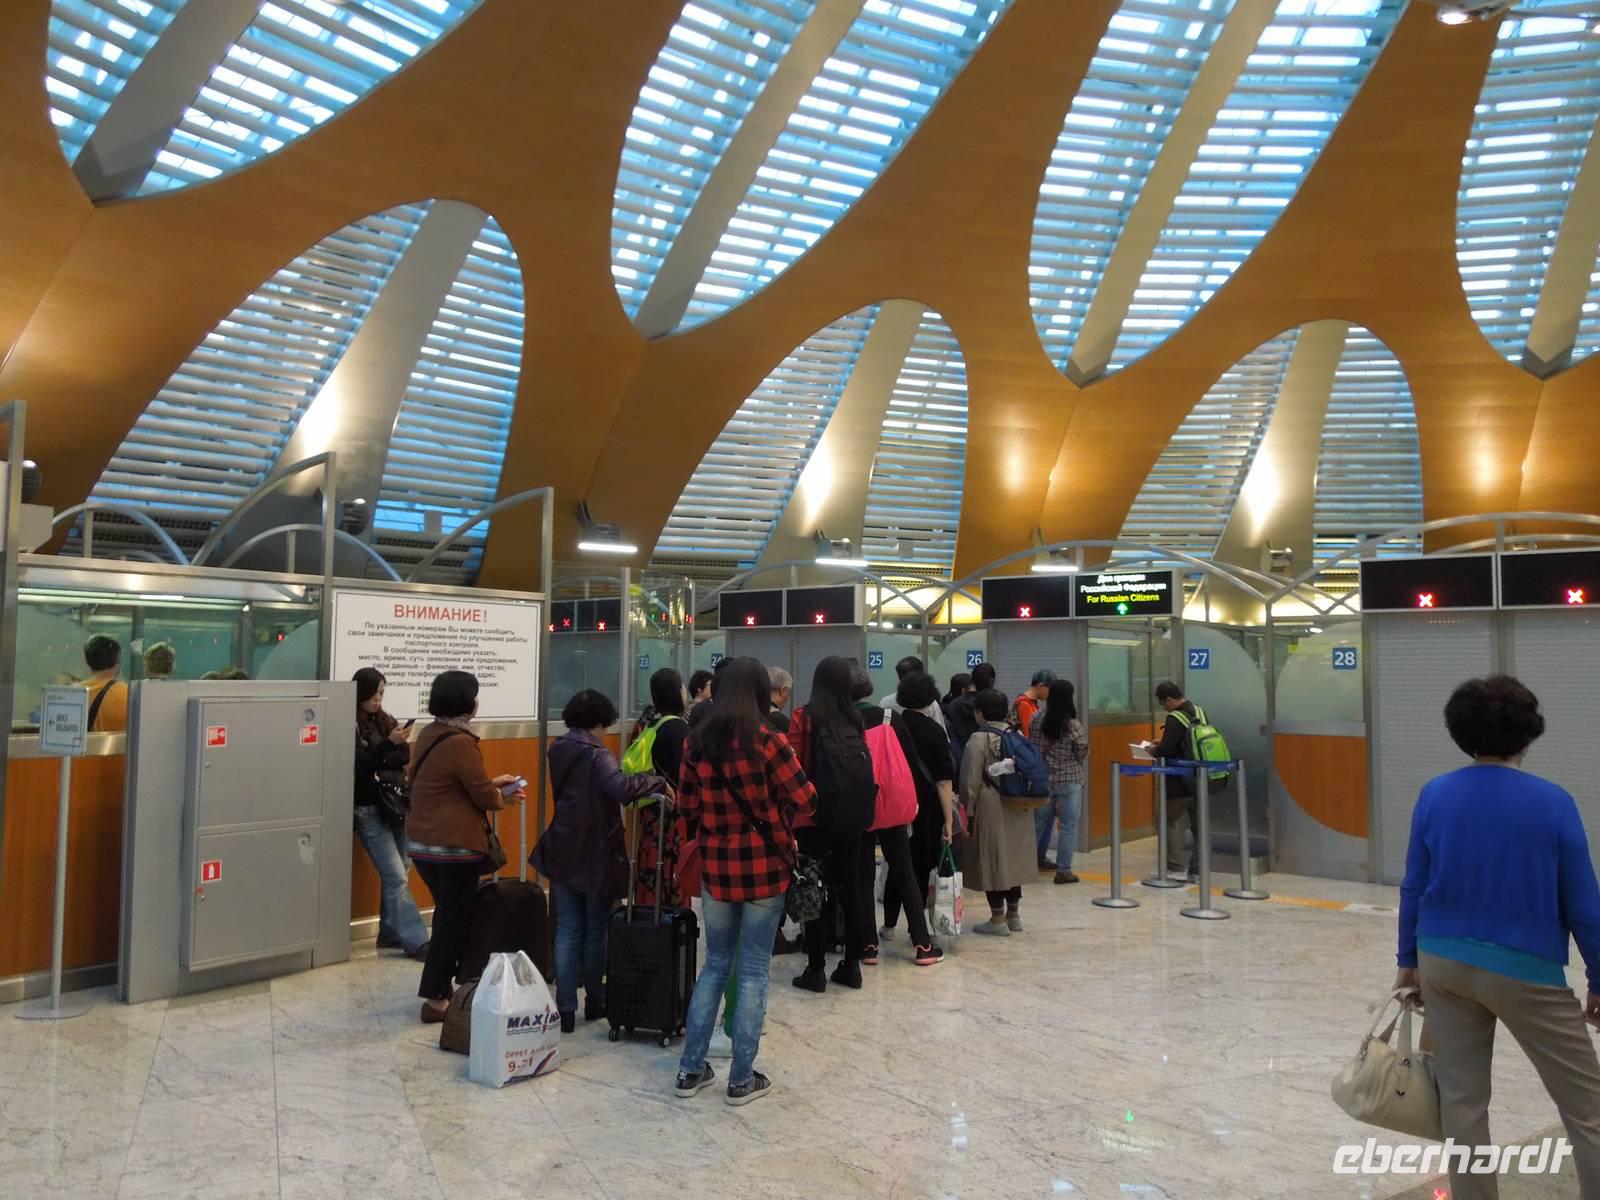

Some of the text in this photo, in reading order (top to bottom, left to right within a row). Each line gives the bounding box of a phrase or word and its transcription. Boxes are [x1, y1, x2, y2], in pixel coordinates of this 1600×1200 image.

[1087, 593, 1160, 603] For Russian Citizens
[394, 604, 487, 623] ВНИМАНИЕ!
[364, 621, 375, 629] По
[376, 623, 415, 632] указанным
[417, 625, 446, 633] номерам
[484, 628, 515, 636] сообщить
[404, 640, 447, 648] паспортного
[413, 632, 458, 640] предложения
[468, 635, 504, 644] улучшению
[505, 636, 528, 644] работы
[390, 647, 429, 655] сообщении
[409, 656, 424, 664] суть
[639, 657, 649, 668] 23
[869, 654, 882, 666] 25
[968, 654, 982, 666] 26
[1190, 652, 1208, 666] 27
[1334, 651, 1355, 666] 28
